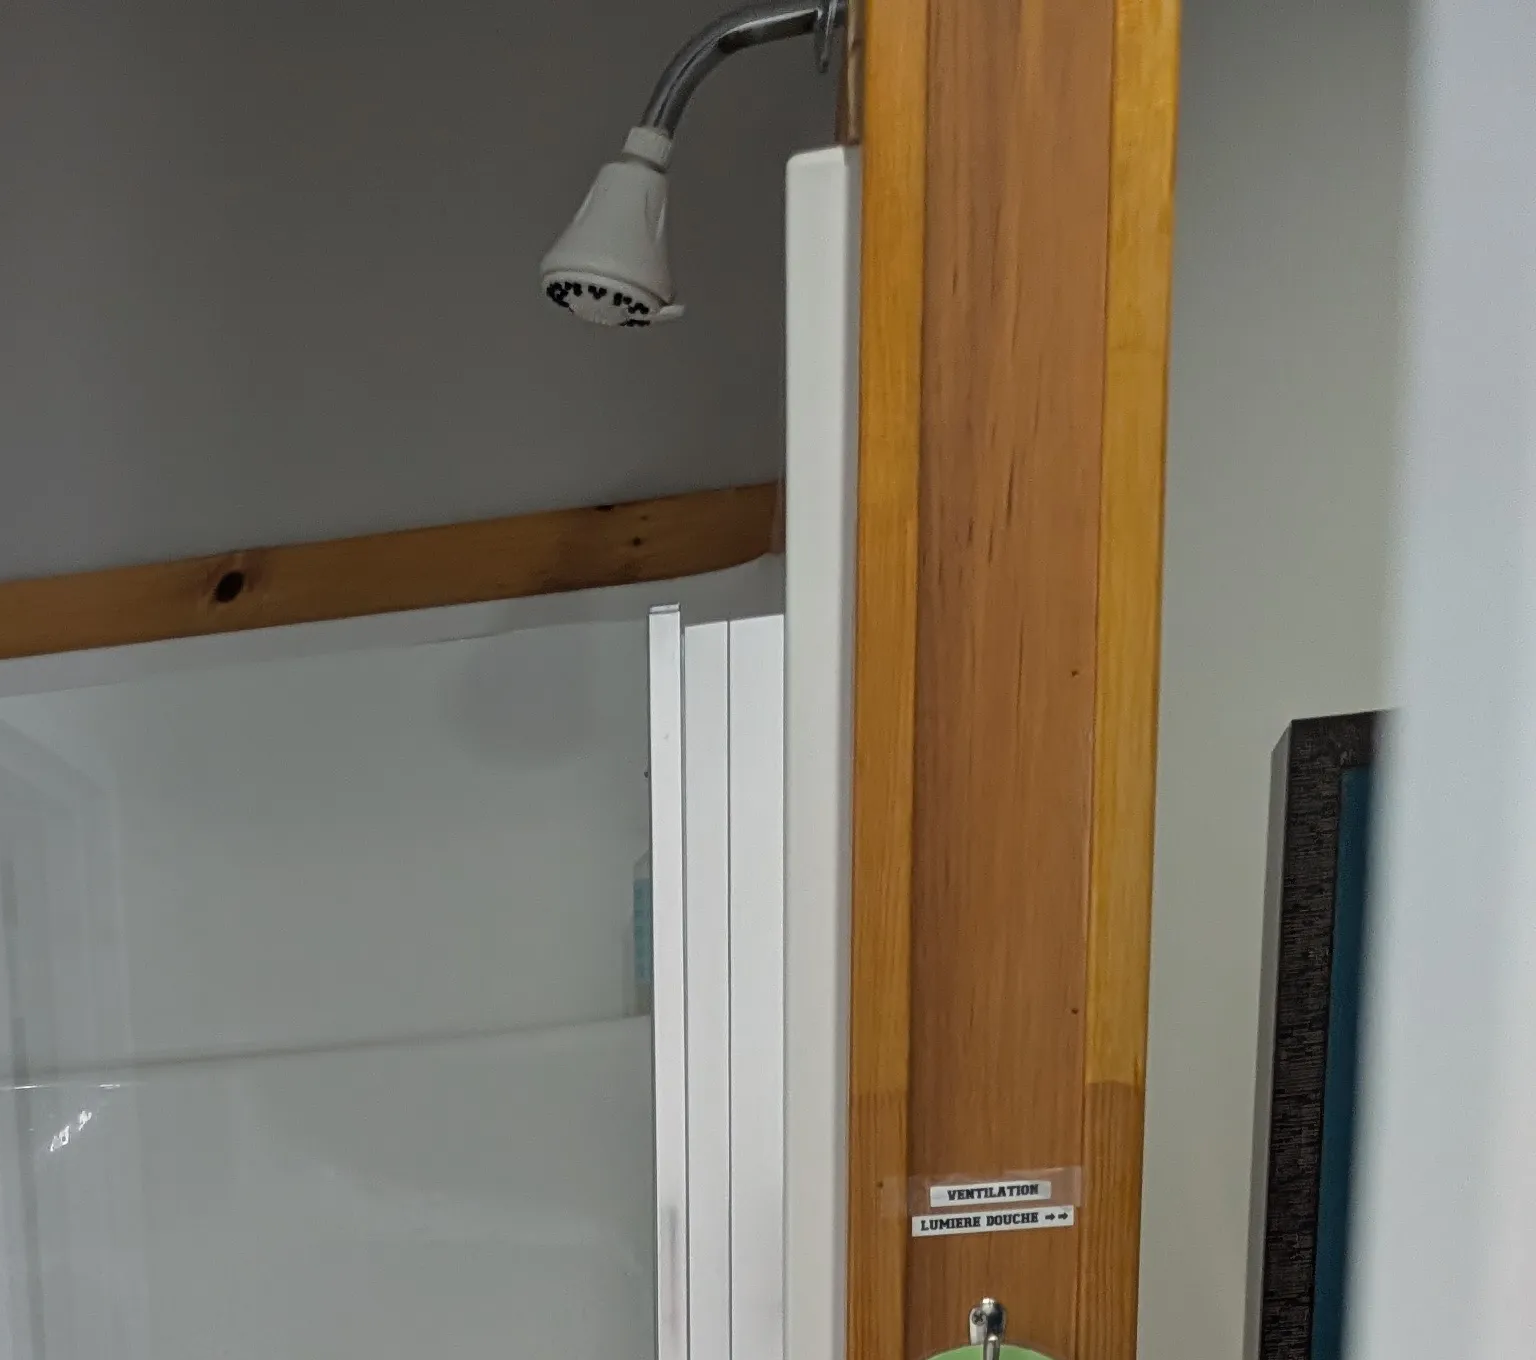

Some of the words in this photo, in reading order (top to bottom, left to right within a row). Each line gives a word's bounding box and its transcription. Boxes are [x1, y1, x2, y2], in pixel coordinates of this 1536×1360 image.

[947, 1184, 1039, 1201] VENTILATION
[921, 1216, 981, 1232] LUMIERE
[986, 1212, 1039, 1226] DOUCHE
